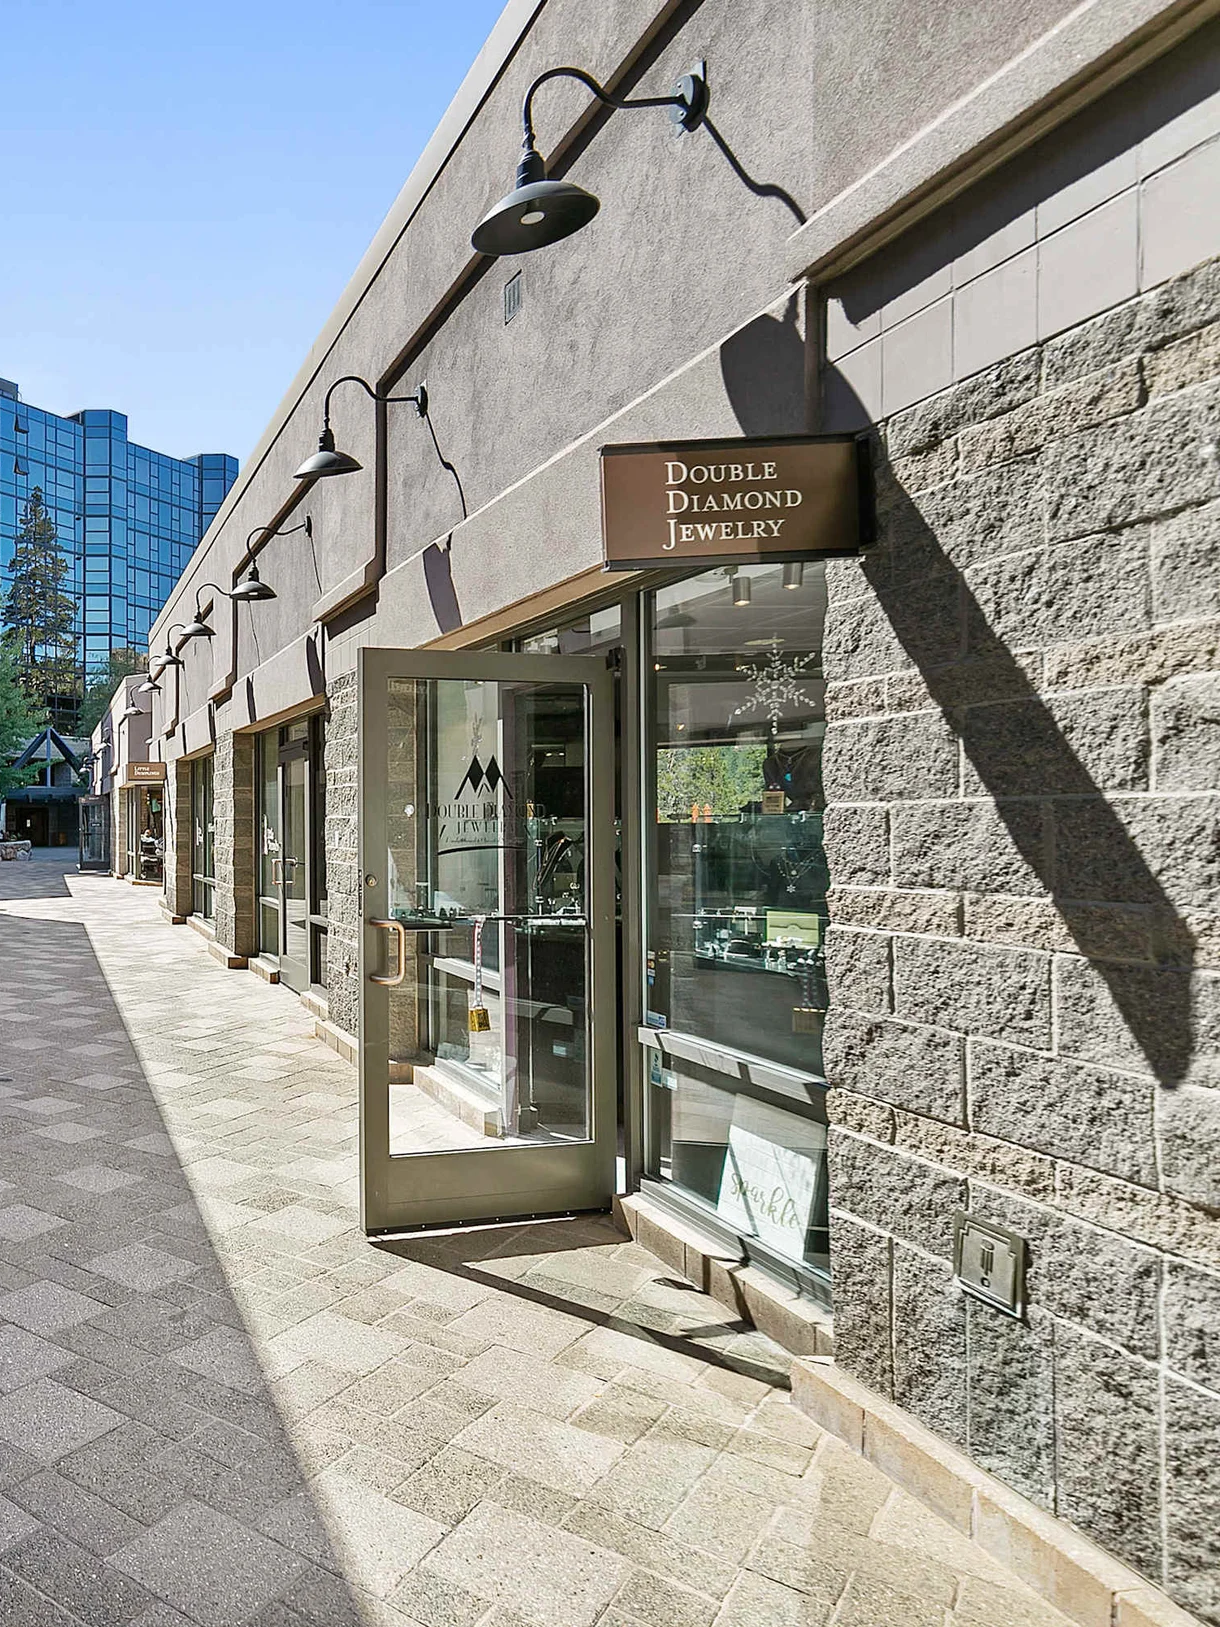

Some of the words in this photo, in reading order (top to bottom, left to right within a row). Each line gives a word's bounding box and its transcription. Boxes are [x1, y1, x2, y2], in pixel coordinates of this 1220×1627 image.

[665, 461, 777, 485] DOUBLE
[665, 489, 802, 514] DIAMOND
[662, 519, 785, 550] JEWELRY
[427, 802, 479, 819] DOUBLE
[483, 802, 545, 819] DIOND
[731, 1173, 801, 1228] sparkle
